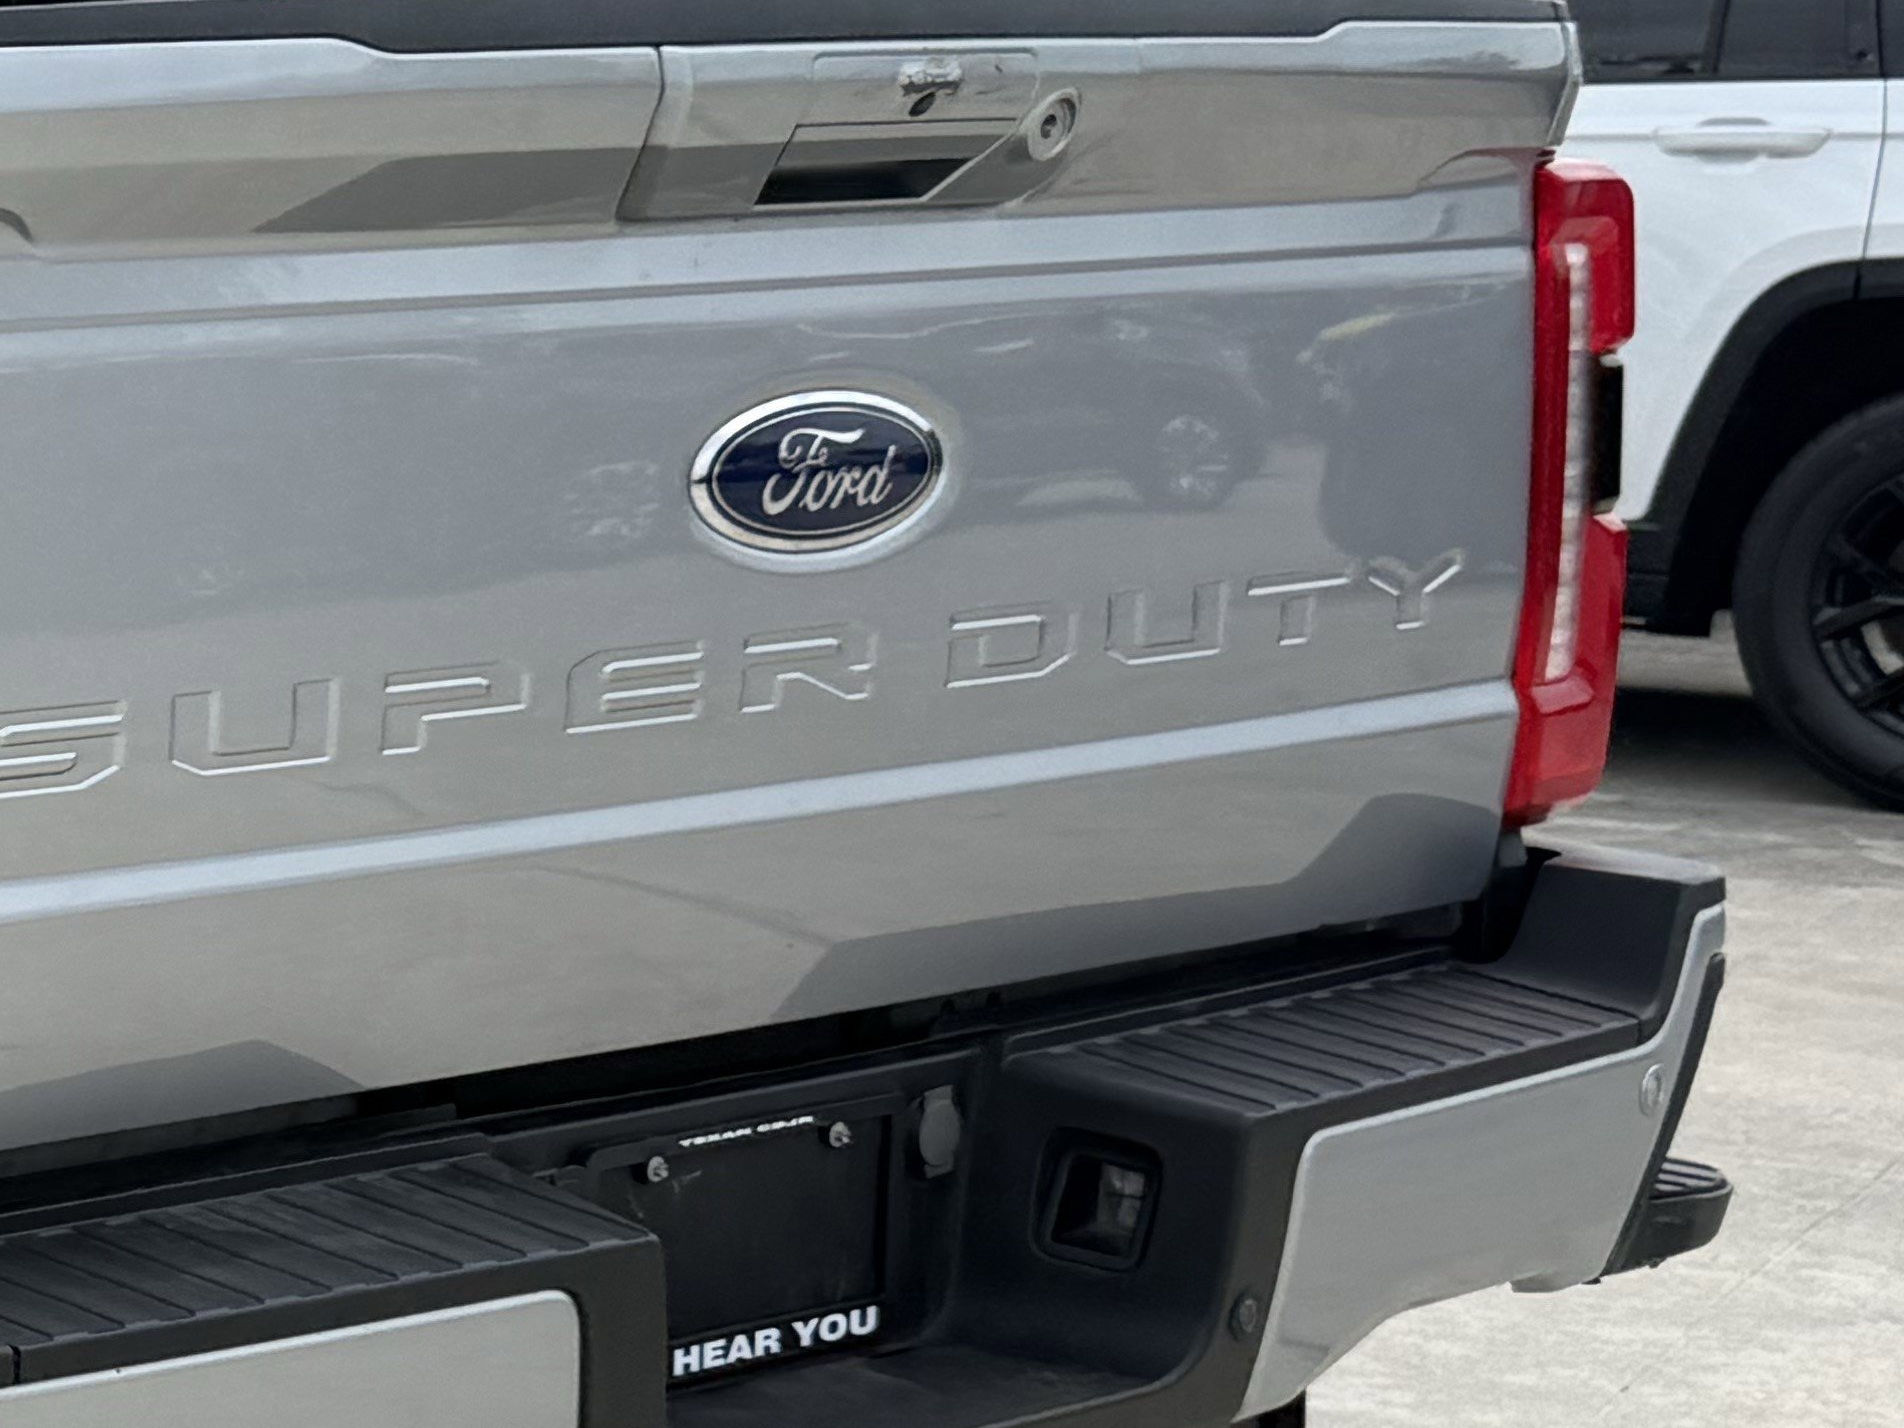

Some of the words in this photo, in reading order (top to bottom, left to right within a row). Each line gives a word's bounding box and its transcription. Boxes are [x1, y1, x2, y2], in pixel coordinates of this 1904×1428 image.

[762, 426, 895, 517] Ford
[945, 550, 1464, 689] DUTY
[672, 1327, 782, 1376] HEAR
[793, 1305, 879, 1348] YOU
